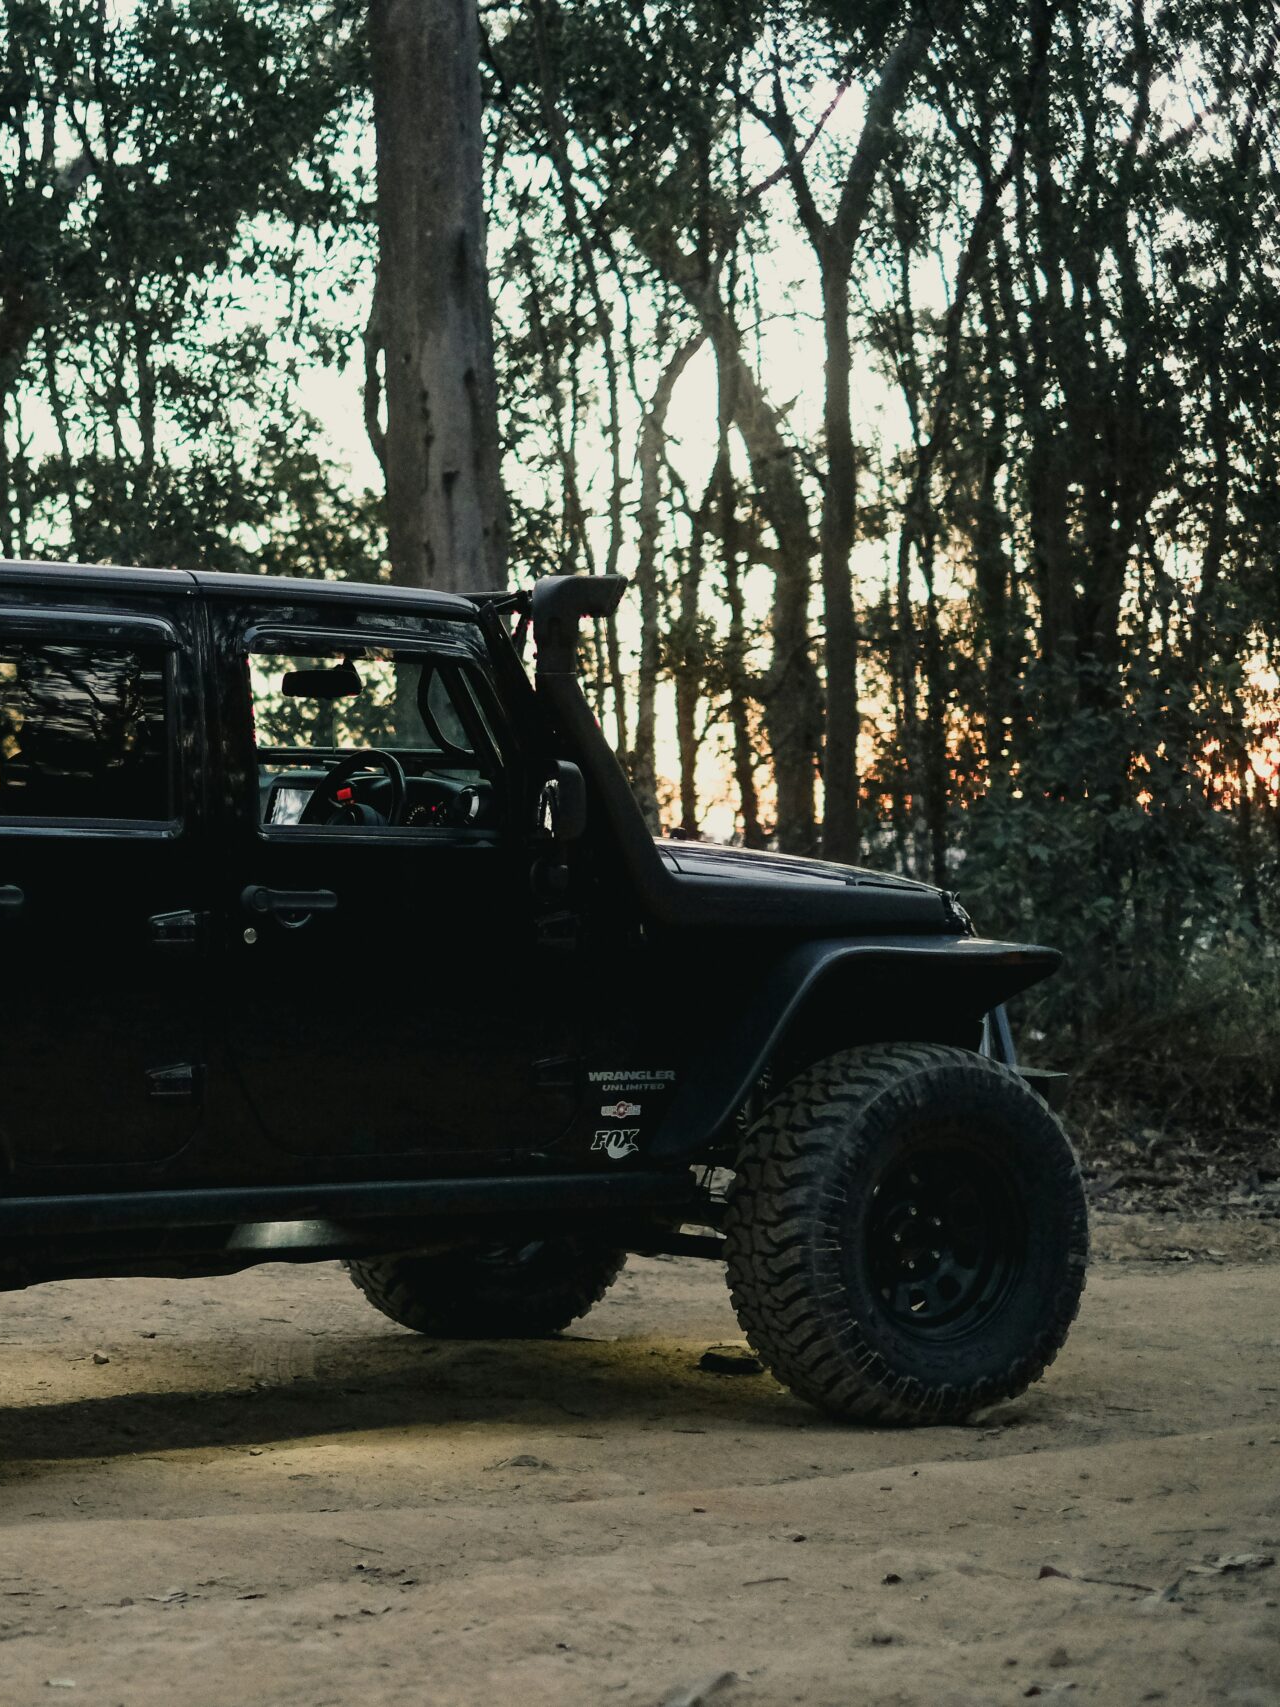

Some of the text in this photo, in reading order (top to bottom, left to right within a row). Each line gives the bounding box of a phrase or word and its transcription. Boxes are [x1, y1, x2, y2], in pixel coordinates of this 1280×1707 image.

[588, 1070, 675, 1082] WRANGLER
[601, 1083, 665, 1091] UNLIMITED
[590, 1129, 640, 1154] FOX
